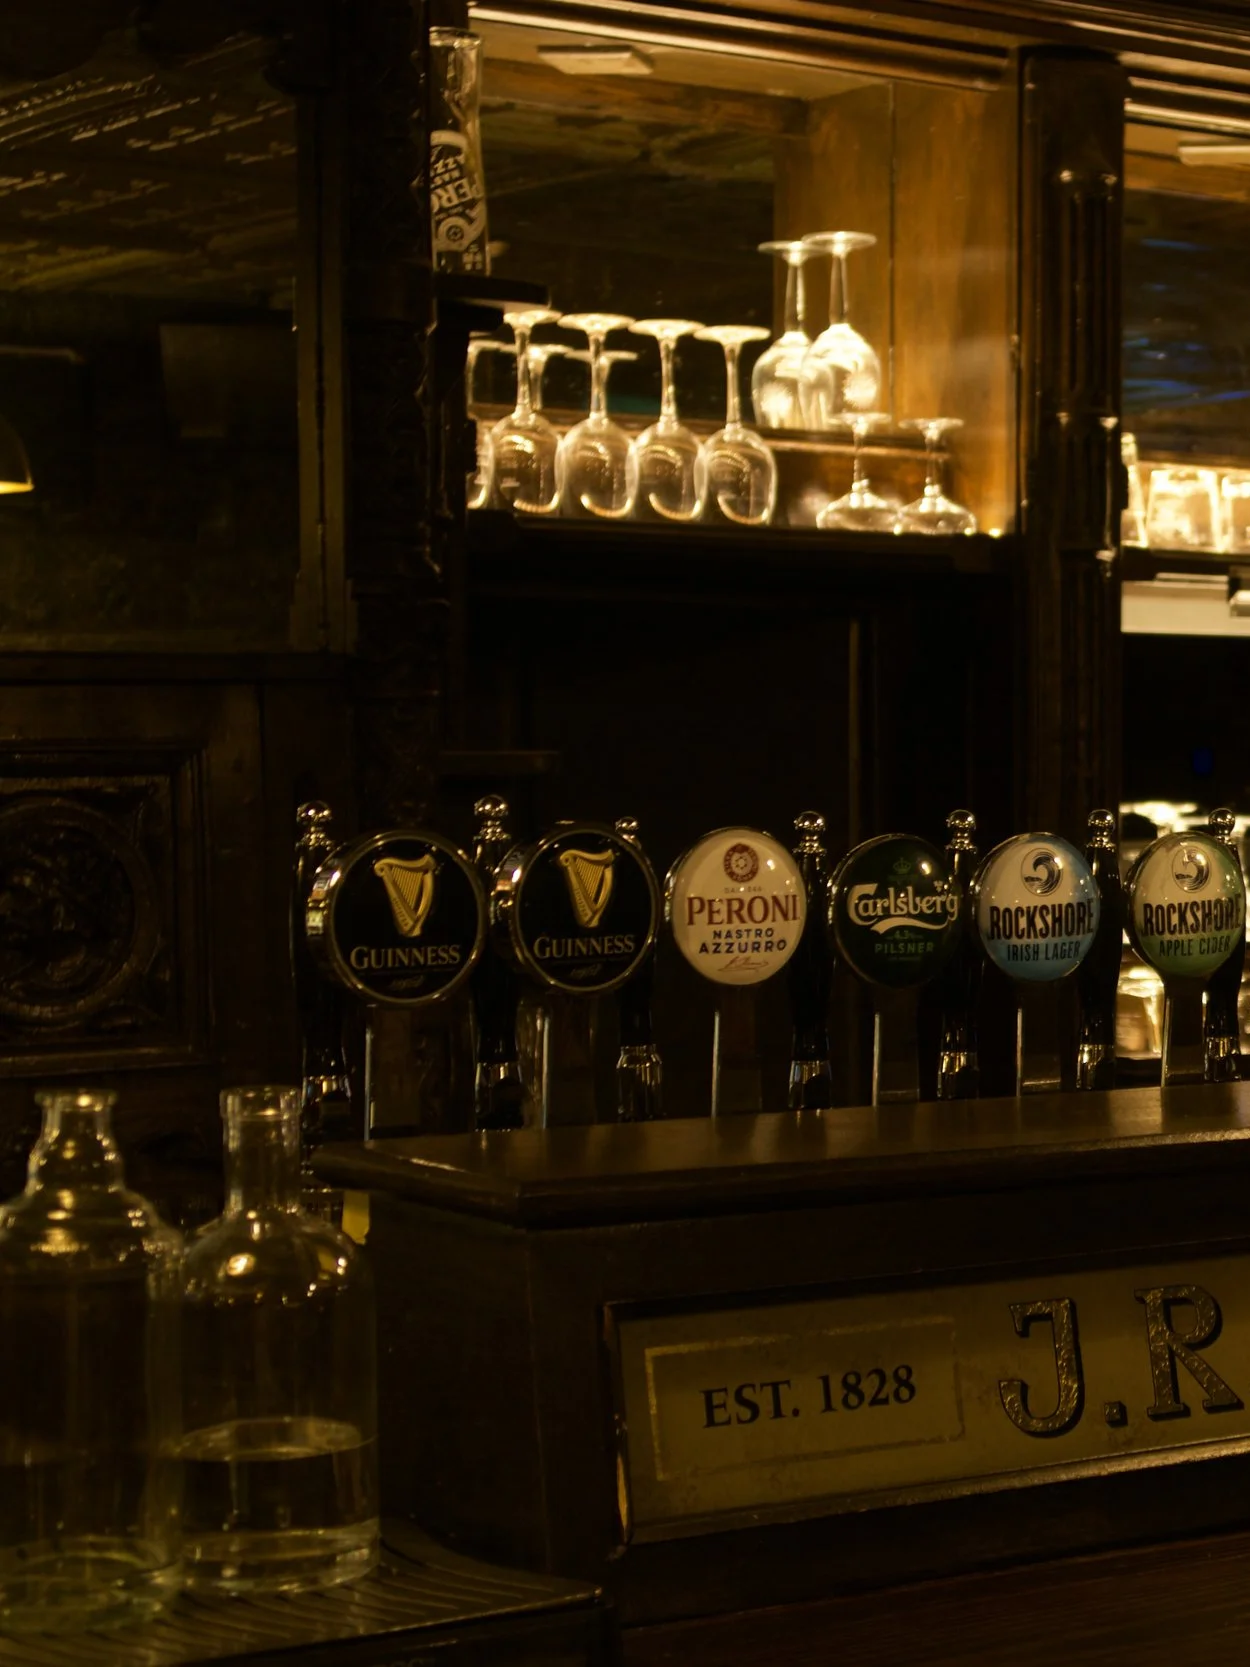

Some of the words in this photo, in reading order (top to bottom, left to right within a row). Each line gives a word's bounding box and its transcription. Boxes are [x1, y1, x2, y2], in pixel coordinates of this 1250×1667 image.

[687, 894, 798, 926] PERONI
[847, 883, 958, 926] Carlsberg
[1142, 894, 1241, 936] ROCKSHORE
[988, 899, 1094, 940] ROCKSHORE
[533, 933, 636, 959] GUINNESS
[699, 940, 787, 954] AZZURRO
[713, 928, 774, 940] NASTRO
[1159, 939, 1193, 956] APPLE
[1199, 936, 1230, 955] CIDER
[349, 944, 461, 970] GUINNESS
[874, 942, 934, 955] PILSNER
[1007, 943, 1039, 961] IRISH
[1044, 941, 1080, 960] LAGER
[701, 1380, 800, 1429] EST.
[819, 1364, 917, 1414] 1828
